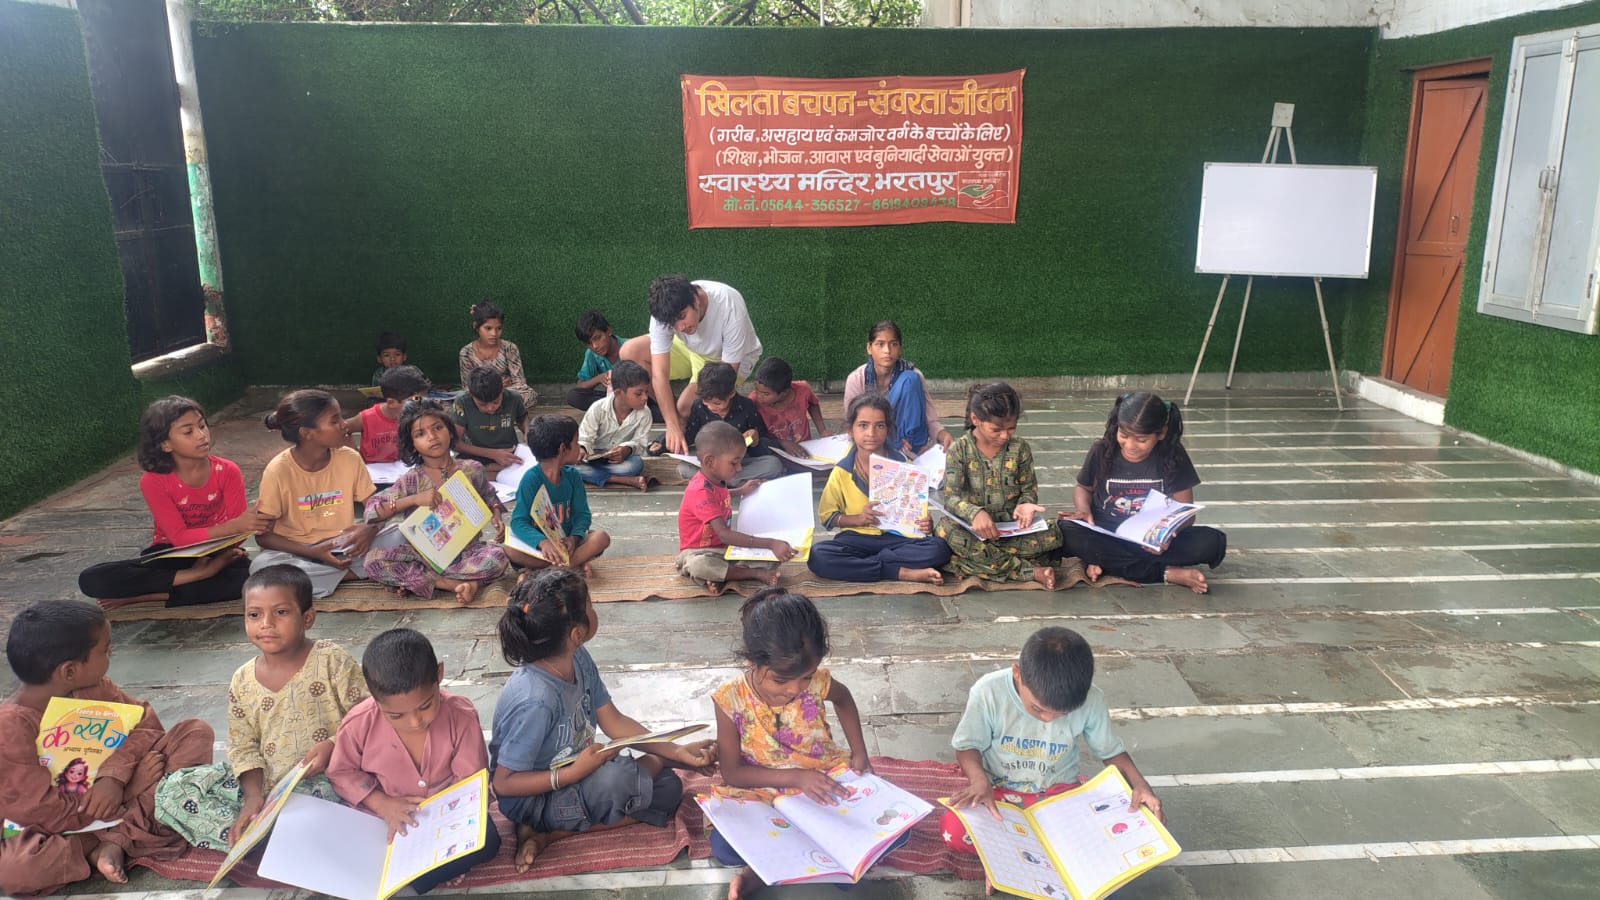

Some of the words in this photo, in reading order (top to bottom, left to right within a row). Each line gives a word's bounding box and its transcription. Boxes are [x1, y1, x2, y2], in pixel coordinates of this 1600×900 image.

[695, 80, 781, 117] खिलता
[949, 79, 1016, 116] जीवन
[887, 120, 909, 141] वर्ग
[698, 173, 795, 193] स्वास्थ्य
[875, 171, 957, 196] भरतपुर
[73, 716, 114, 742] ख
